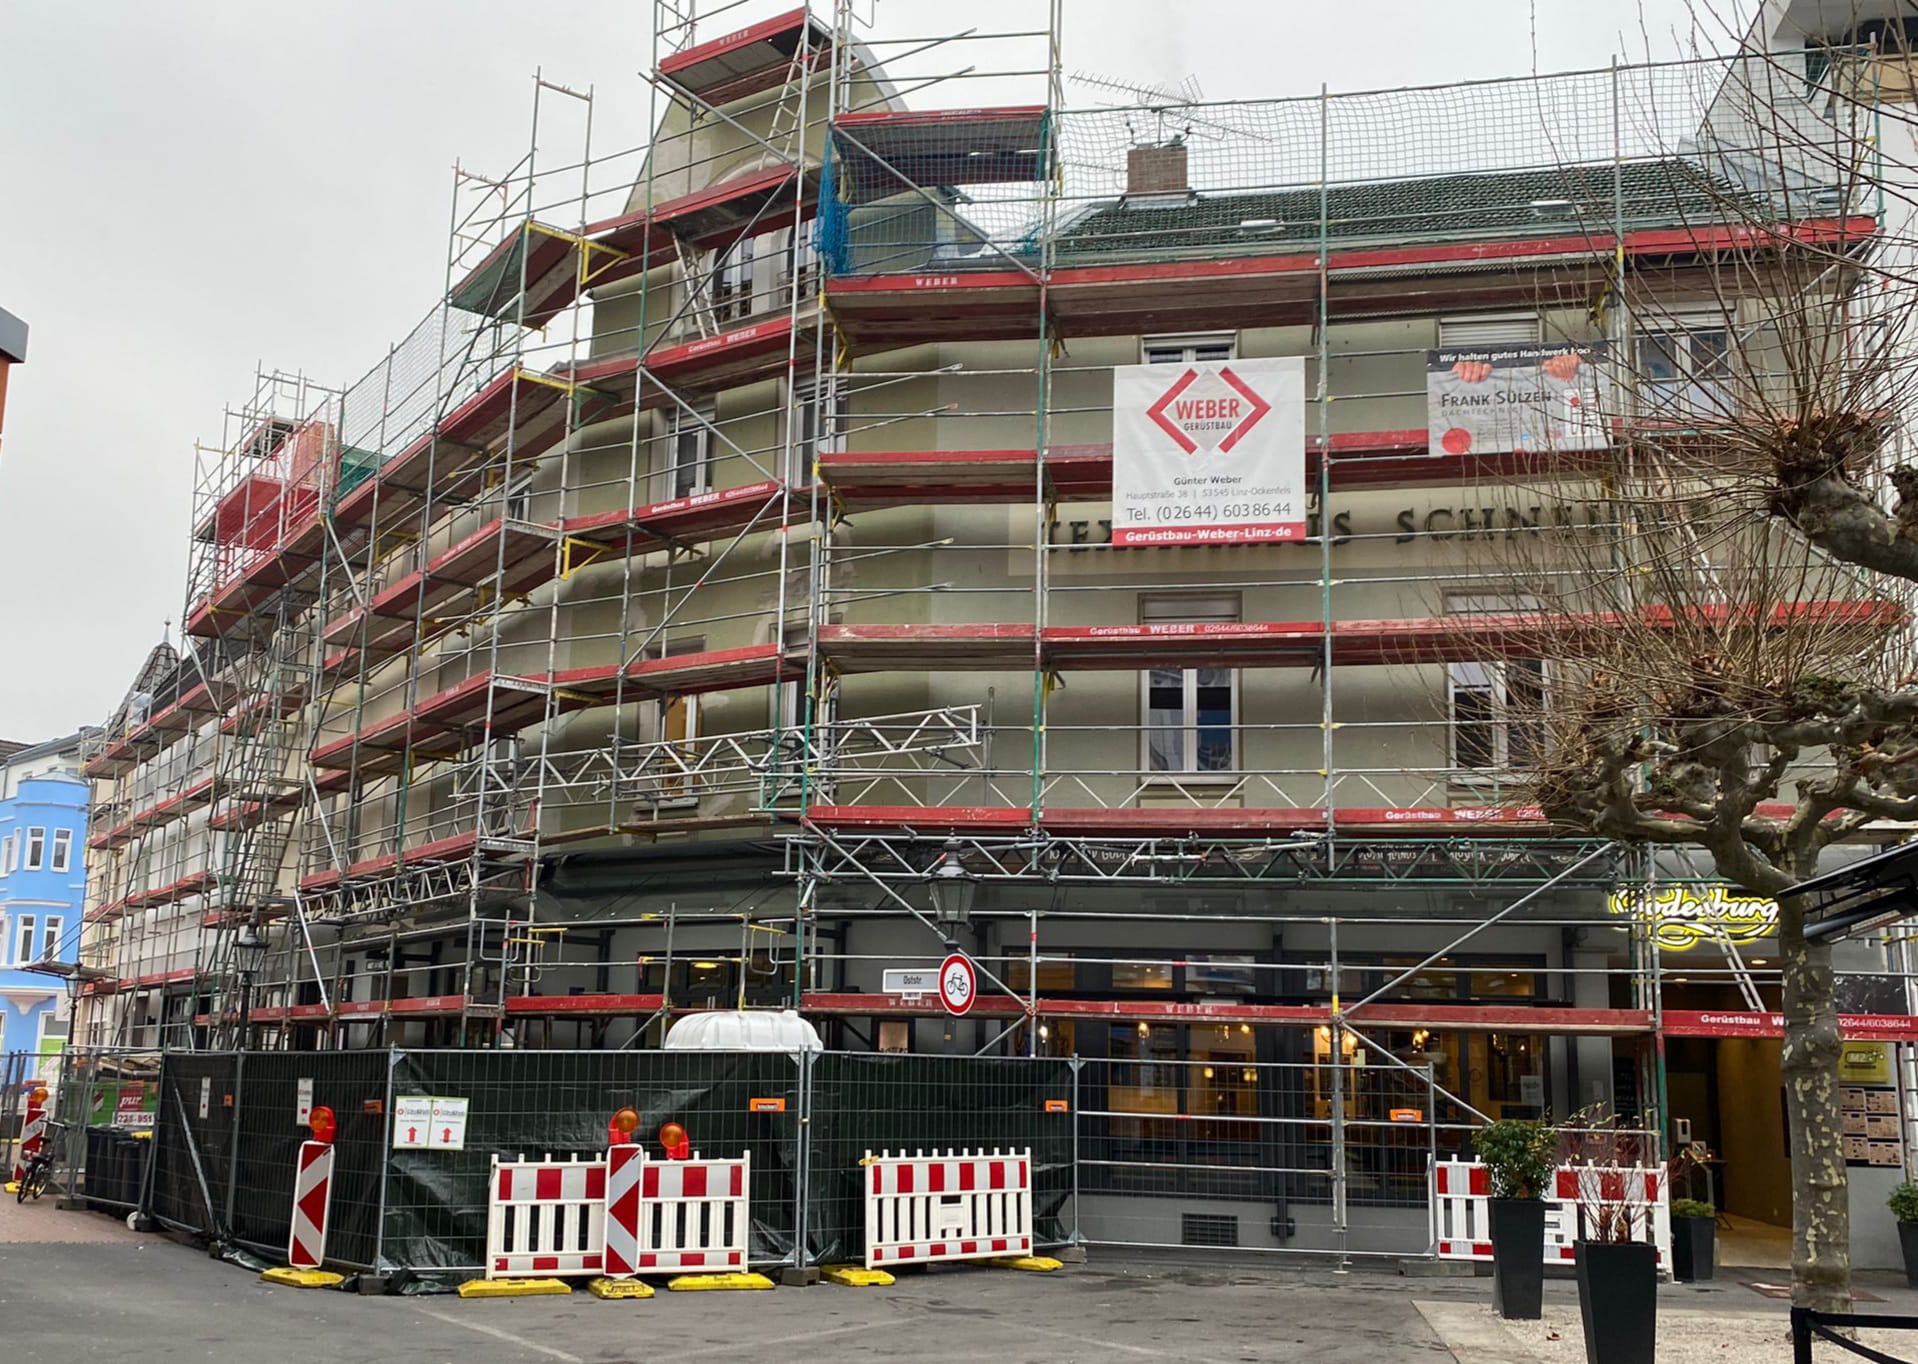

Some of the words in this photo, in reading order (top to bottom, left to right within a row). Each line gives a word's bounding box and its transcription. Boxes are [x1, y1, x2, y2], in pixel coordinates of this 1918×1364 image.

[915, 276, 958, 287] WEBER
[1439, 352, 1456, 363] Wir
[1458, 350, 1487, 363] halten
[1490, 350, 1518, 363] gutes
[1519, 346, 1569, 359] Handwerk
[1441, 393, 1491, 409] FRANK
[1495, 388, 1551, 406] SÜLZEN
[1175, 399, 1239, 420] WEBER
[1184, 421, 1232, 432] GERÜSTBAU
[1173, 477, 1208, 487] Günter
[1210, 475, 1243, 485] Weber
[690, 492, 720, 507] WEBER
[1177, 489, 1189, 499] 38
[1126, 507, 1151, 522] Tel.
[1089, 626, 1141, 636] Gerüstbau
[1149, 623, 1196, 635] WEBER
[1385, 810, 1442, 820] Gerüstbau
[1700, 1014, 1761, 1025] Gerüstbau
